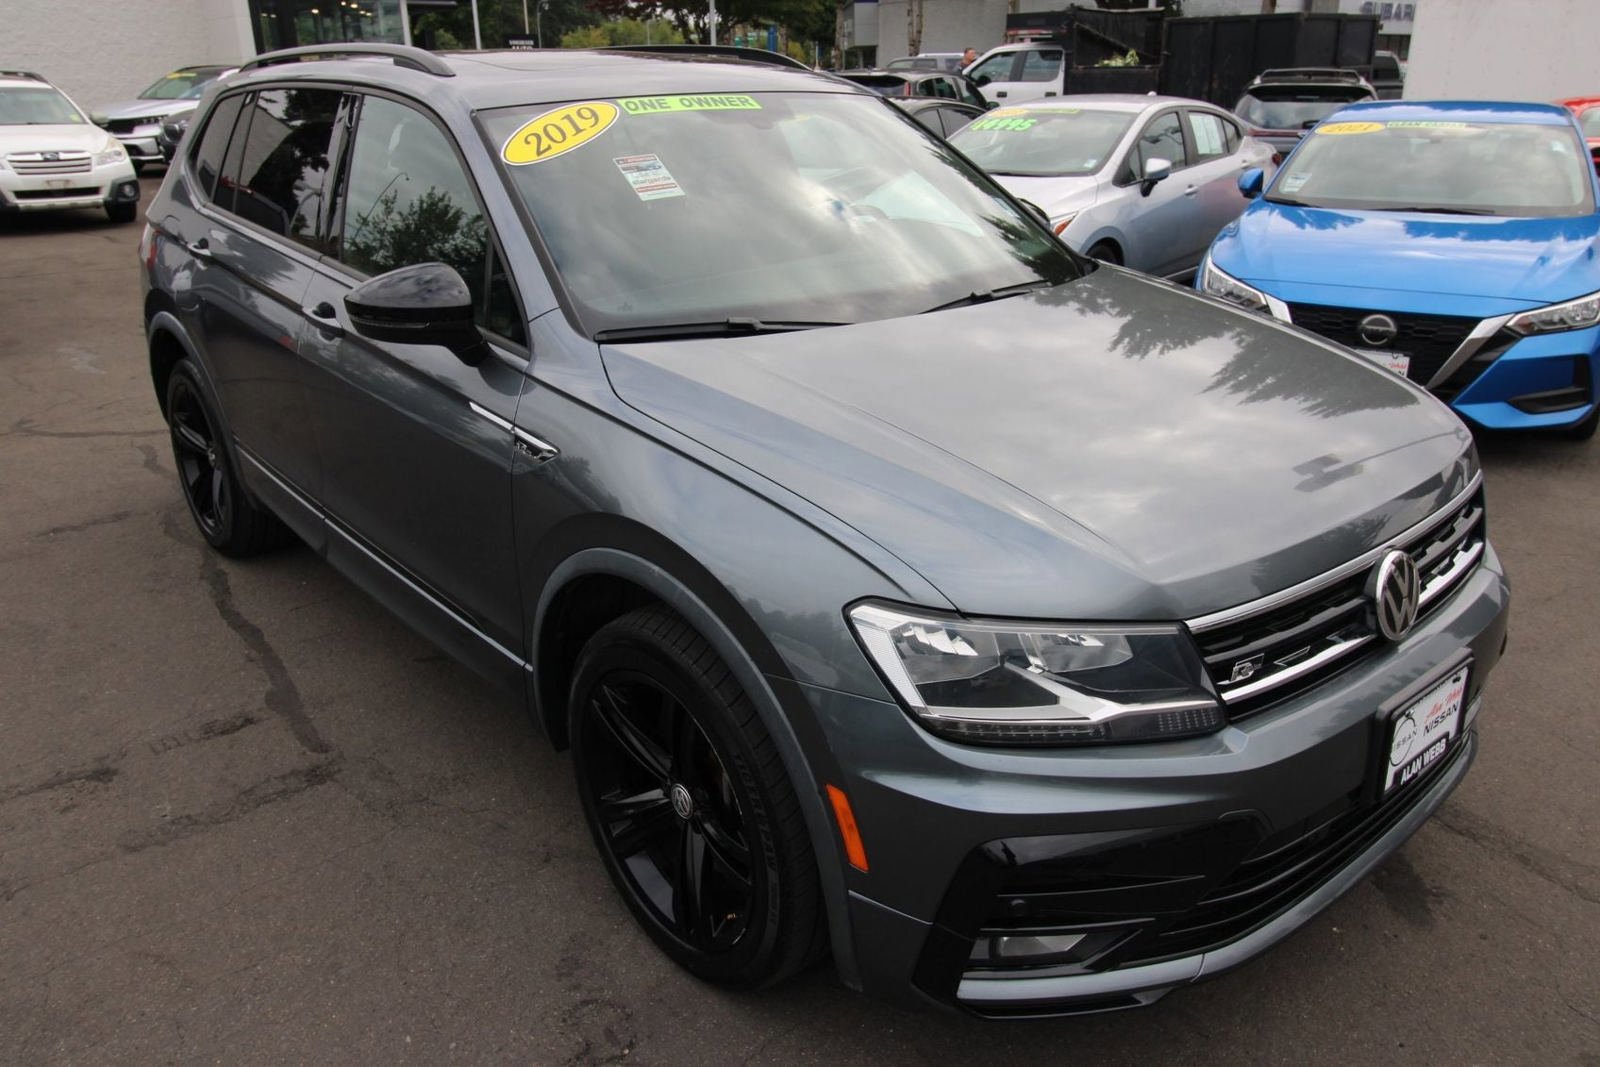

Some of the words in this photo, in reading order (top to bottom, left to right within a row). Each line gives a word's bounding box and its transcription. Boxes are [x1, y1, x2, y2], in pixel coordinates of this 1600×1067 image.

[624, 98, 671, 112] ONE
[680, 96, 753, 108] OWNER
[524, 106, 599, 157] 2019
[1423, 702, 1458, 737] NISSAN
[1401, 755, 1422, 786] ALAN
[1423, 738, 1446, 766] WEBB
